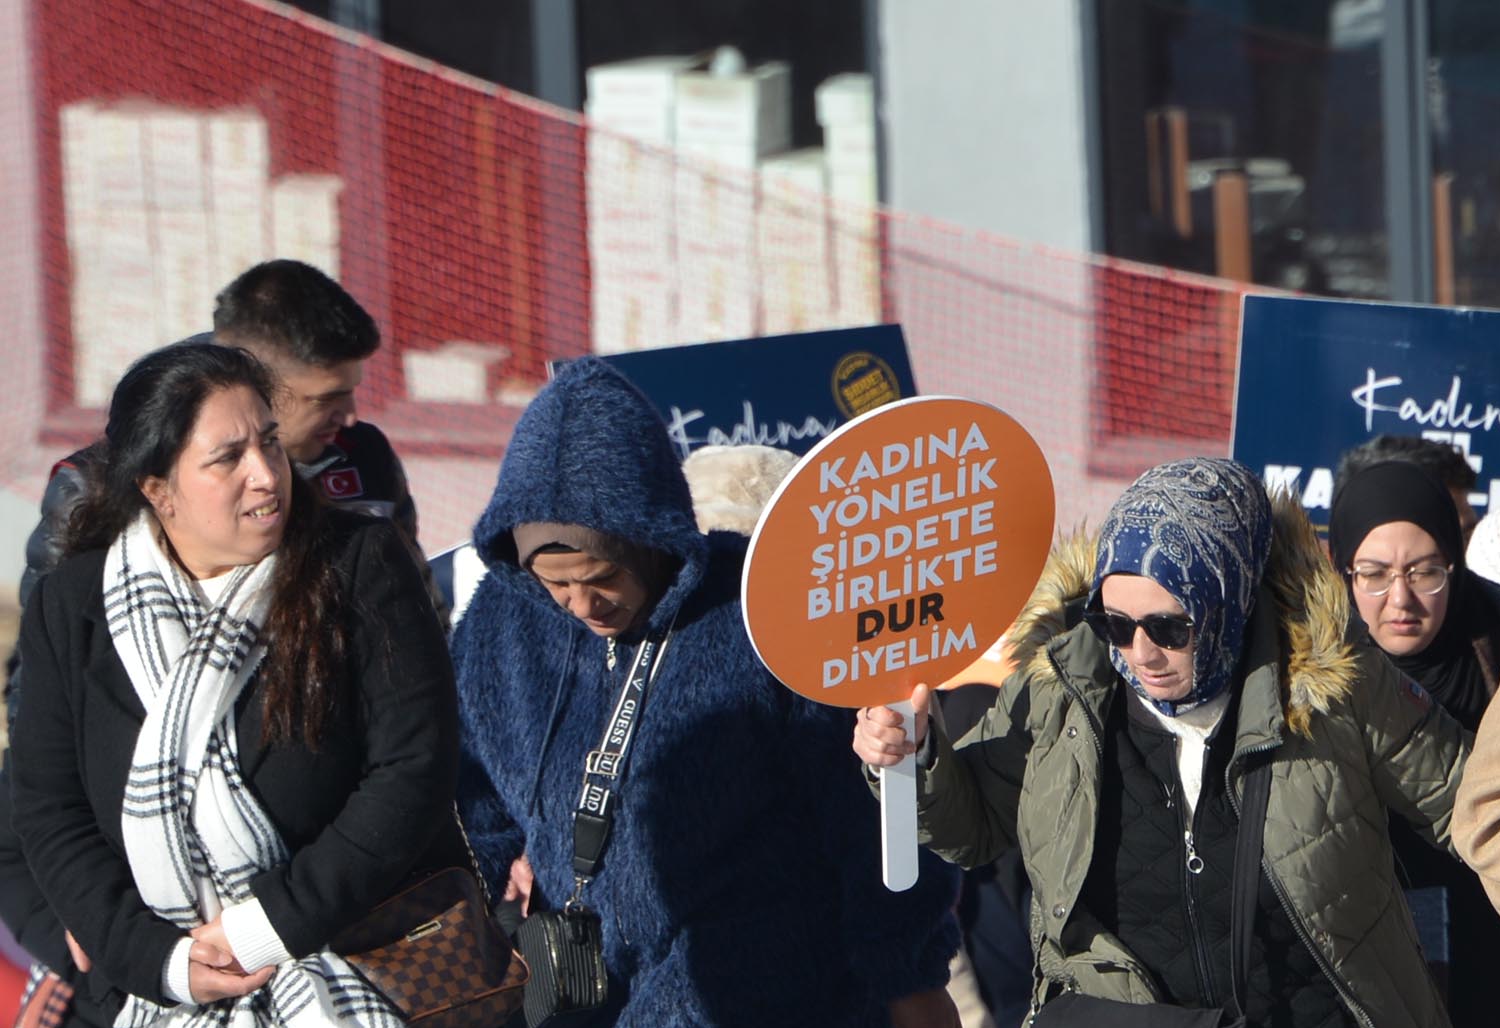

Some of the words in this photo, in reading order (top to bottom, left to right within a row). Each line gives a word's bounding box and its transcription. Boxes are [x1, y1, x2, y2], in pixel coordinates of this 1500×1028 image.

[819, 421, 990, 494] KADINA
[809, 458, 998, 535] YÖNELİK
[810, 501, 995, 584] ŞİDDETE
[807, 541, 998, 621] BİRLİKTE
[857, 592, 945, 643] DUR
[822, 622, 977, 689] DİYELİM
[611, 699, 636, 745] GUESS
